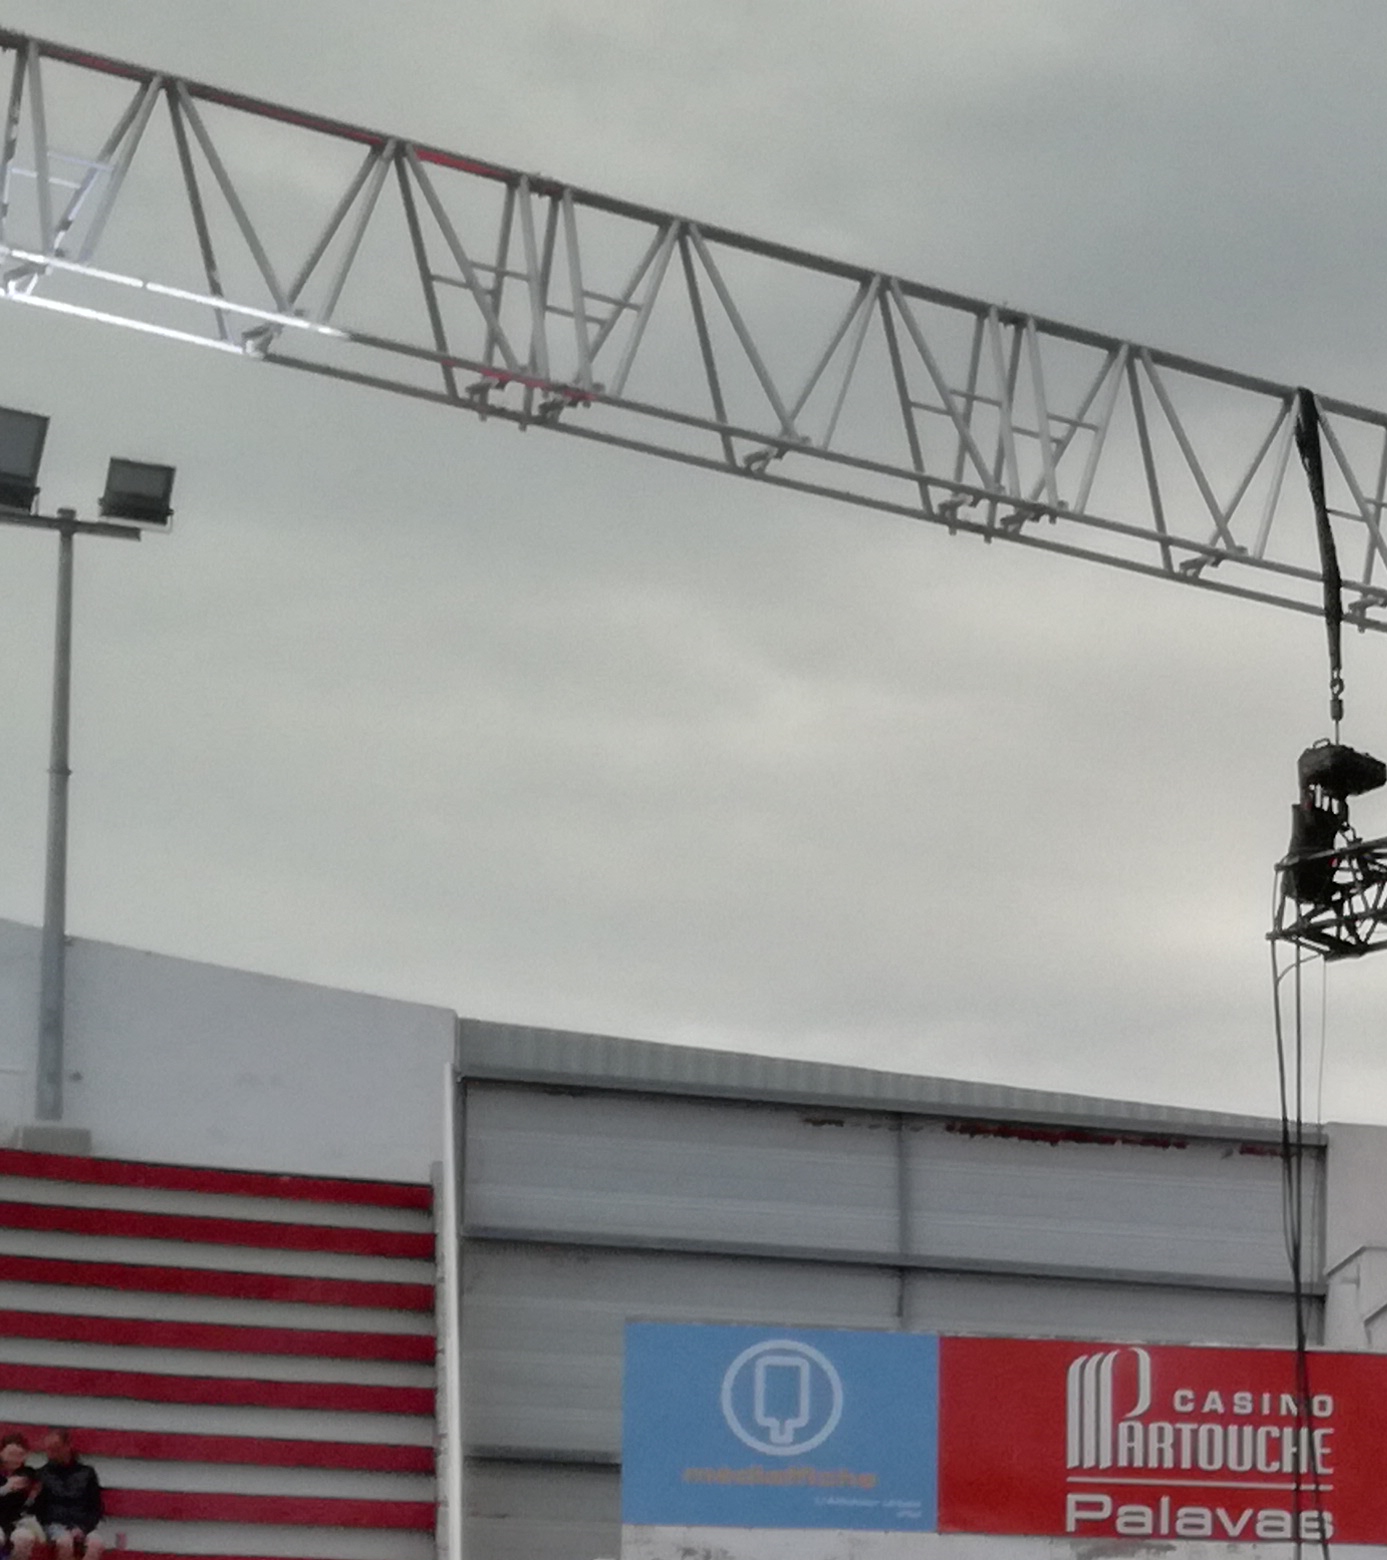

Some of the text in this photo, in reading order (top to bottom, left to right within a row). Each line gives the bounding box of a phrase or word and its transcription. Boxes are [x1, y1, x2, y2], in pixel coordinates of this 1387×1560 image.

[1065, 1346, 1336, 1475] PARTOUCHE
[1172, 1388, 1335, 1418] CASINO
[1065, 1492, 1335, 1541] Palavas
